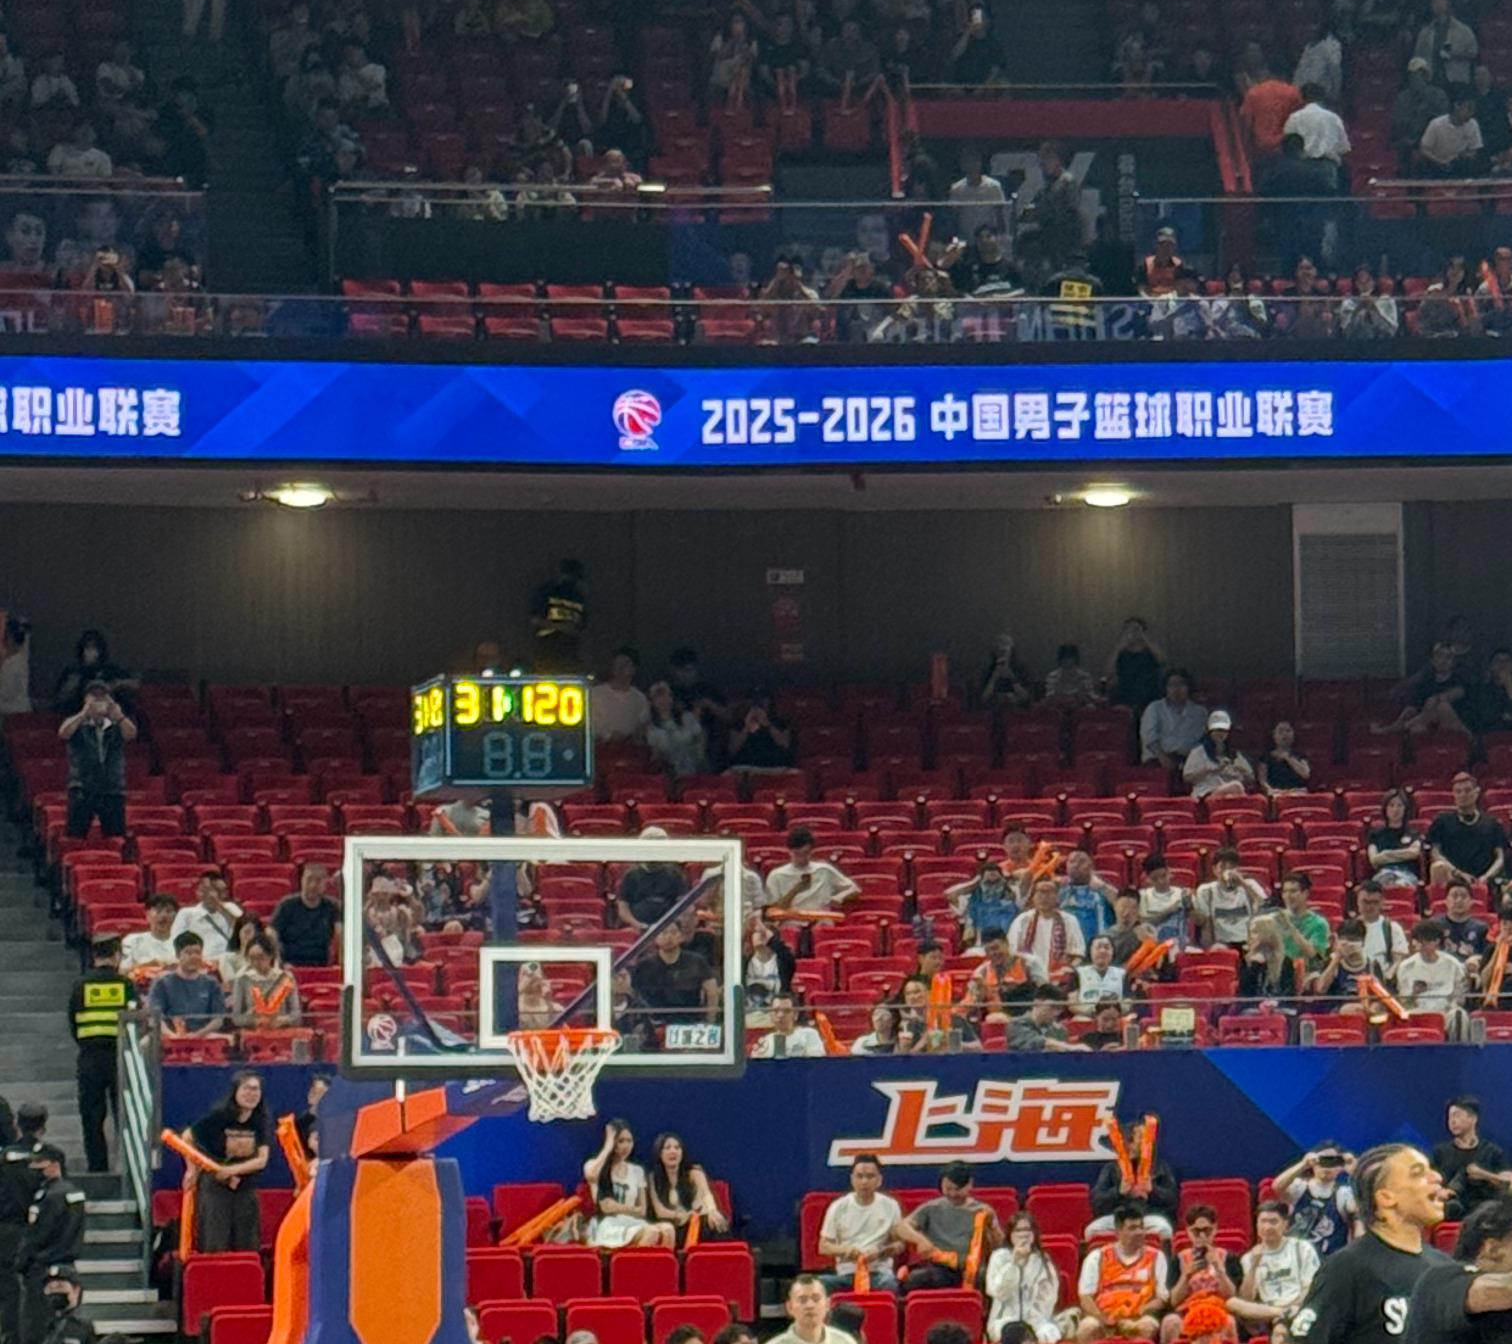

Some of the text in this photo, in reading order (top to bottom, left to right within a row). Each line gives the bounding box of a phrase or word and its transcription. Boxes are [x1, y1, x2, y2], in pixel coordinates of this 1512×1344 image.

[0, 387, 182, 436] 职业联赛
[702, 392, 1333, 444] 2025-2026 中国男子篮球职业联赛
[828, 1080, 1120, 1166] 上海
